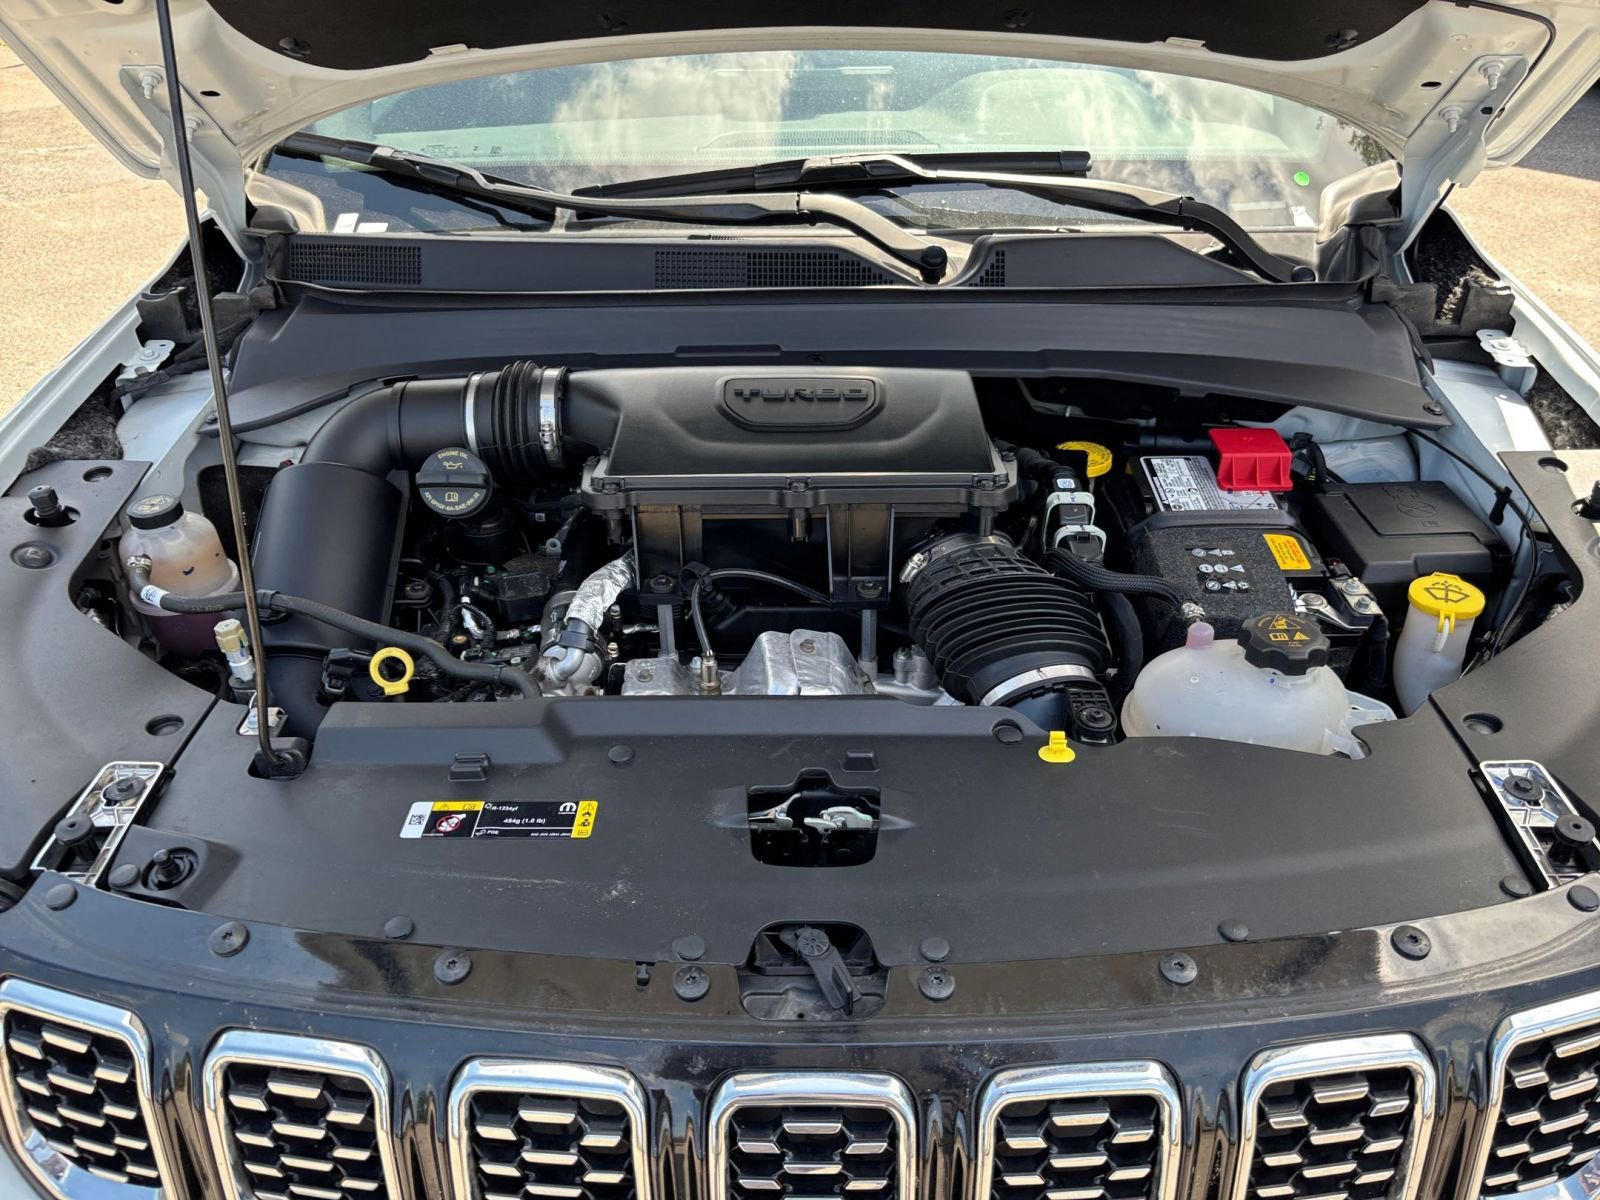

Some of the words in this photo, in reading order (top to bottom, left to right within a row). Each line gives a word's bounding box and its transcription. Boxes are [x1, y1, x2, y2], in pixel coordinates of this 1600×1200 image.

[734, 388, 868, 402] TURBO
[437, 450, 459, 459] ENGINE
[459, 451, 469, 459] OIL
[521, 817, 535, 825] (1.0
[536, 817, 546, 825] lb)
